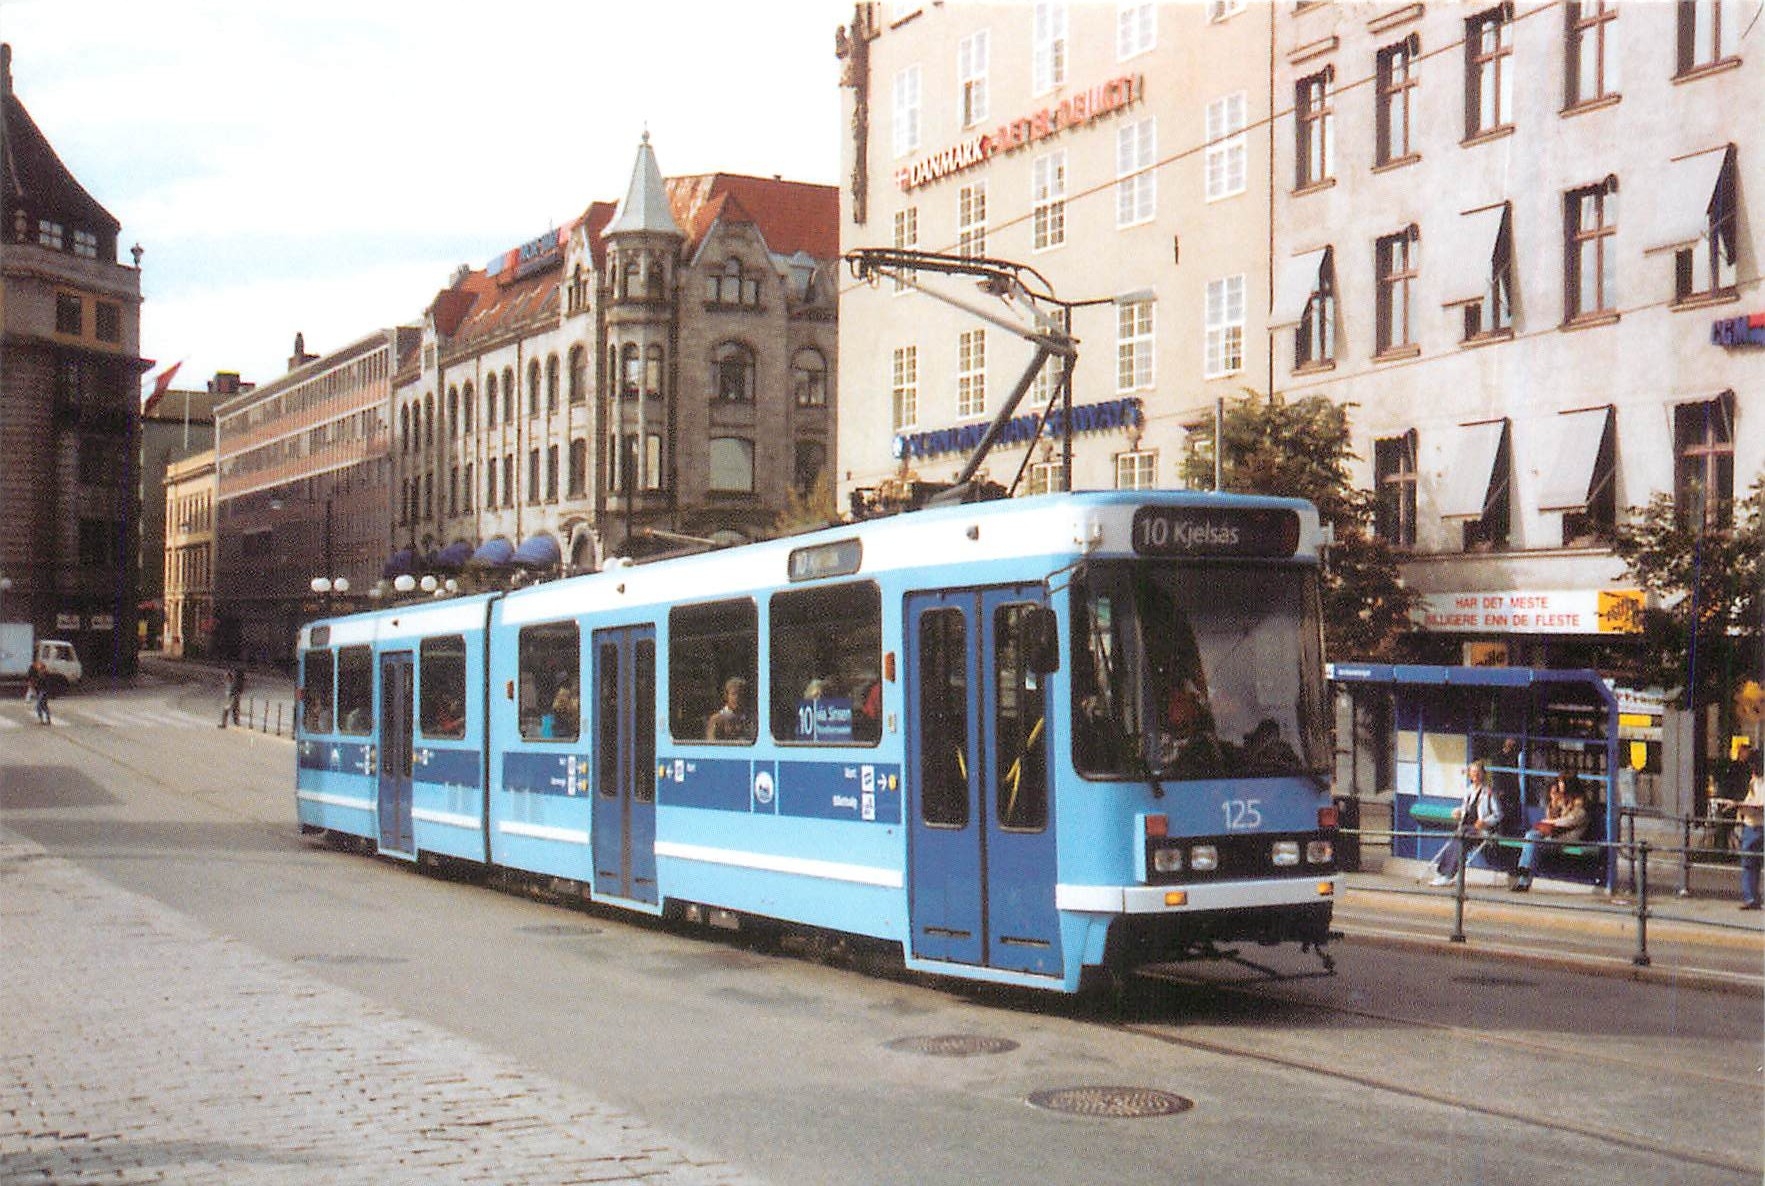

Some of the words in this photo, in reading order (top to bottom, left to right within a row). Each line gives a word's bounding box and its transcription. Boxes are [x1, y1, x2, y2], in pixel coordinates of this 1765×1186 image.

[1143, 517, 1169, 545] 10
[1456, 597, 1477, 609] HAR
[1483, 597, 1504, 609] DET
[1510, 596, 1549, 609] MESTE
[1485, 614, 1508, 626] ENN
[1512, 614, 1530, 626] DE
[1535, 613, 1581, 627] FLESTE
[799, 705, 813, 735] 10
[1221, 799, 1263, 829] 125
